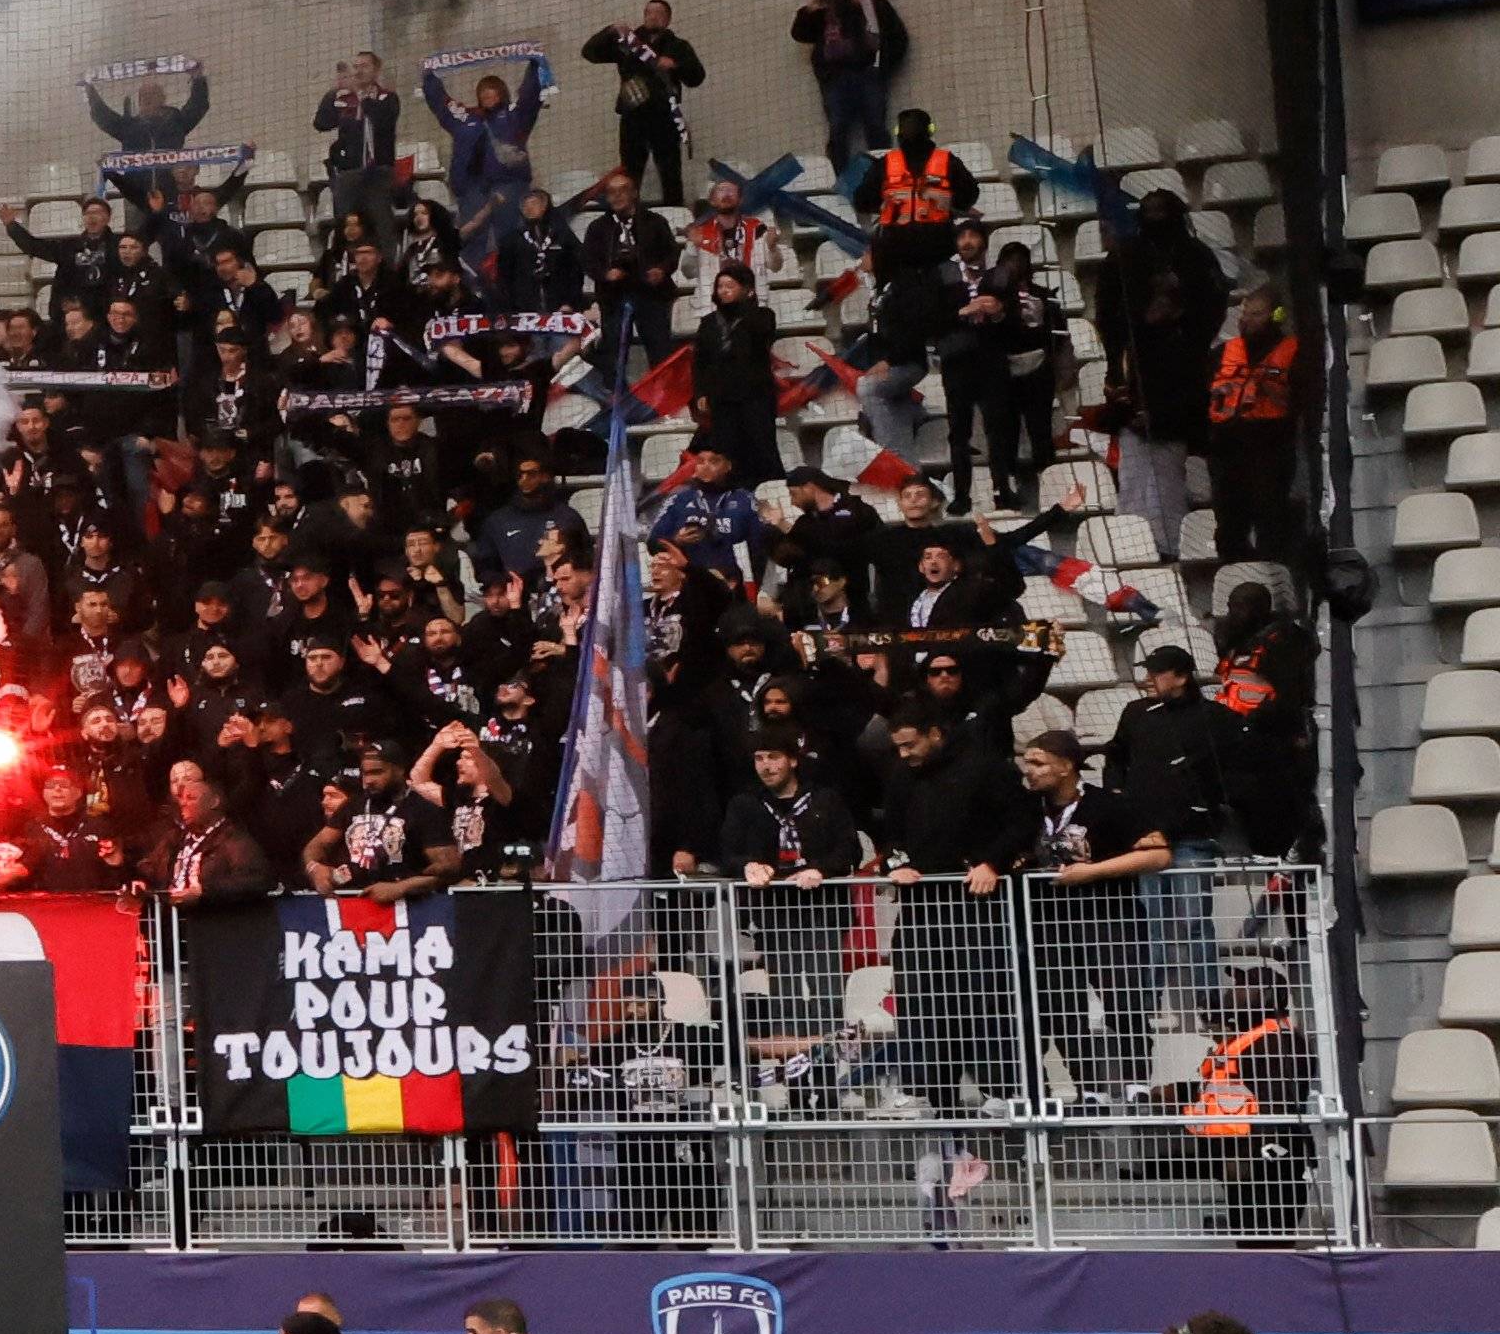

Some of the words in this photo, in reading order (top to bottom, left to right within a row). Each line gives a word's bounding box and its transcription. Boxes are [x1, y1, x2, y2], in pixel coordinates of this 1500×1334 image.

[285, 926, 453, 979] KAMA
[293, 978, 447, 1029] POUR
[213, 1025, 531, 1081] TOUJOURS
[667, 1285, 732, 1306] PARIS
[739, 1288, 767, 1306] FC
